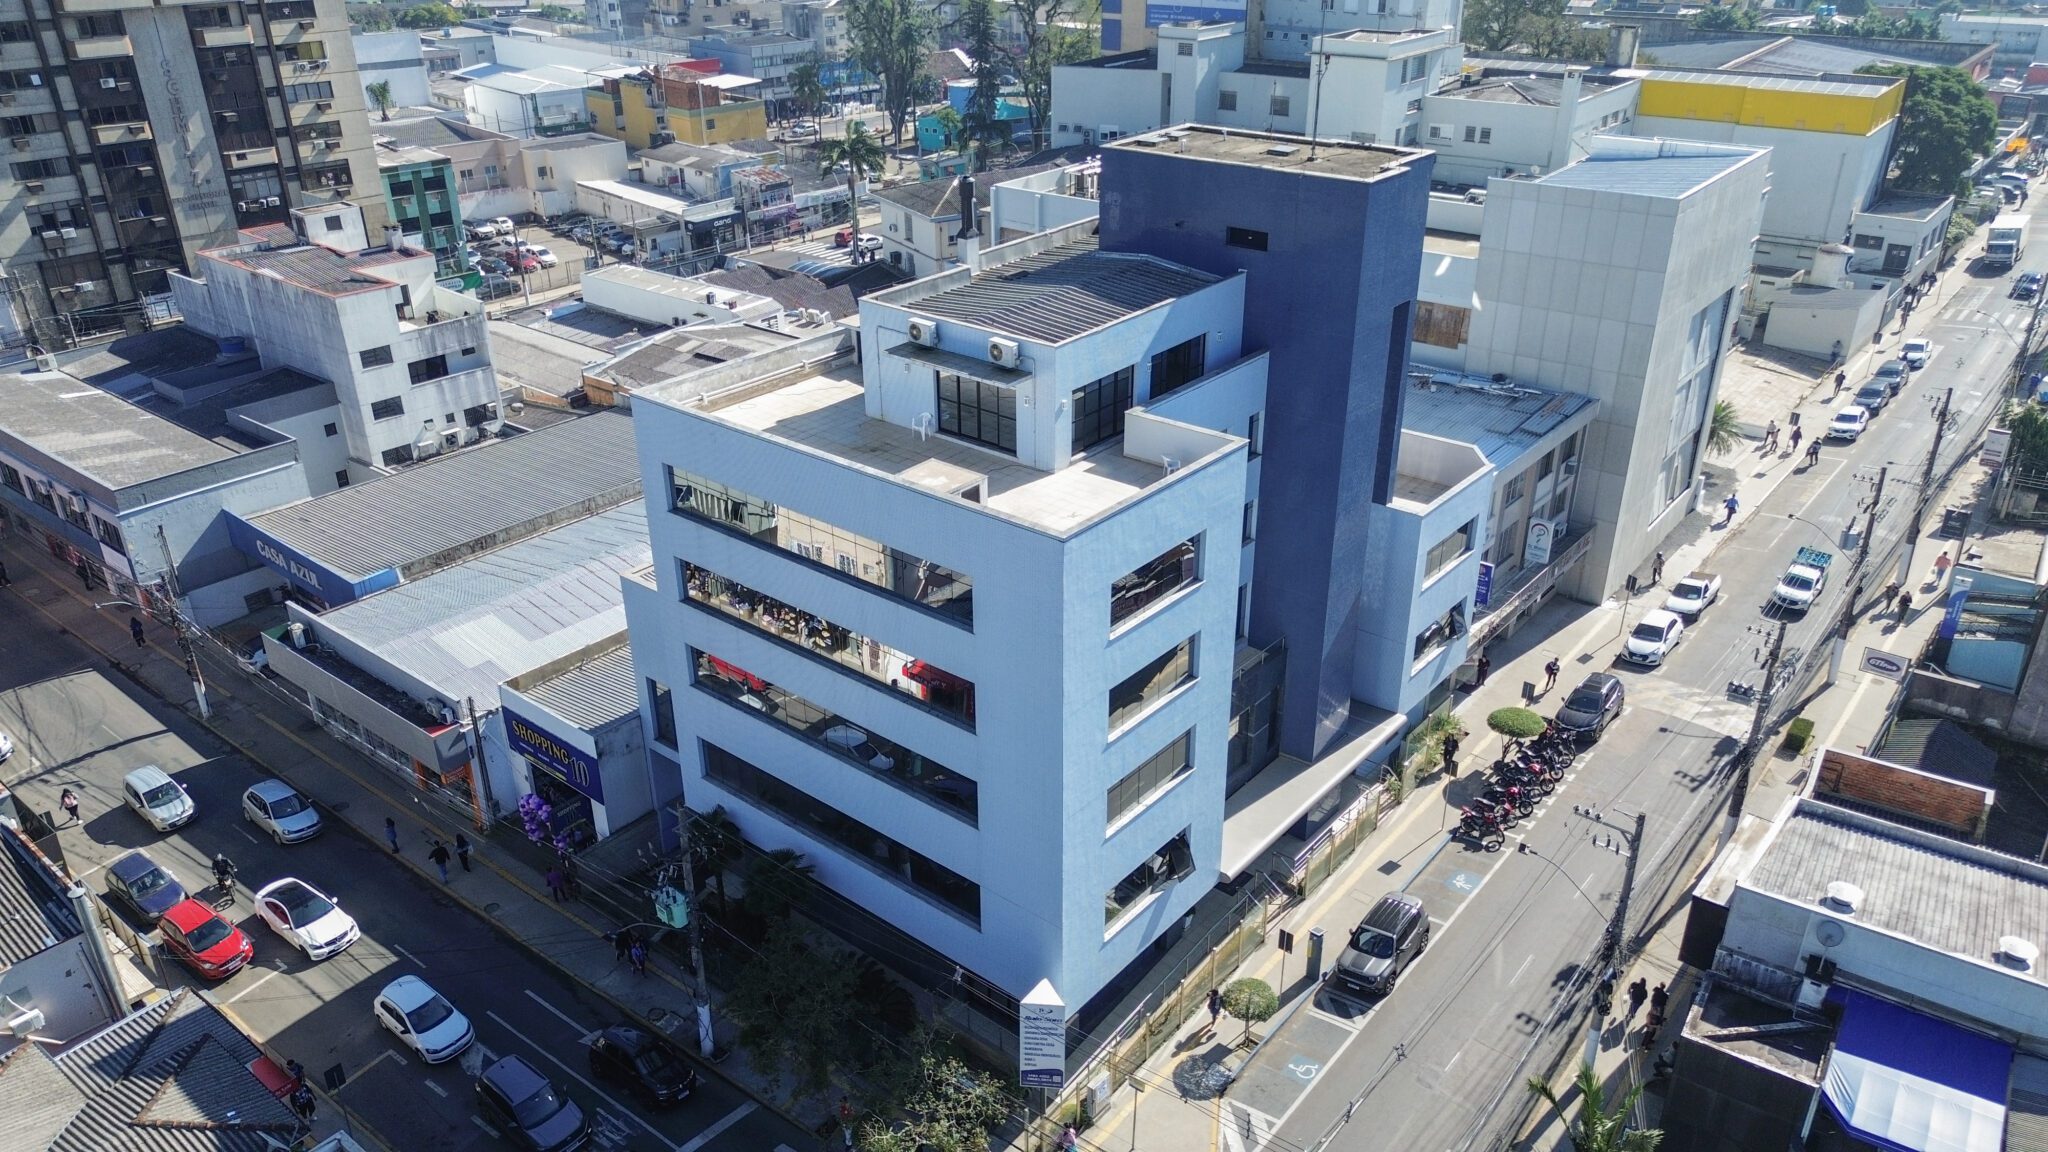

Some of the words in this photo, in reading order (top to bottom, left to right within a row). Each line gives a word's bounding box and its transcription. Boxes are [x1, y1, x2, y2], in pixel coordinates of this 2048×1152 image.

[256, 540, 288, 570] CASA
[290, 560, 323, 591] AZUL
[512, 720, 569, 764] SHOPPING
[569, 757, 590, 787] 10
